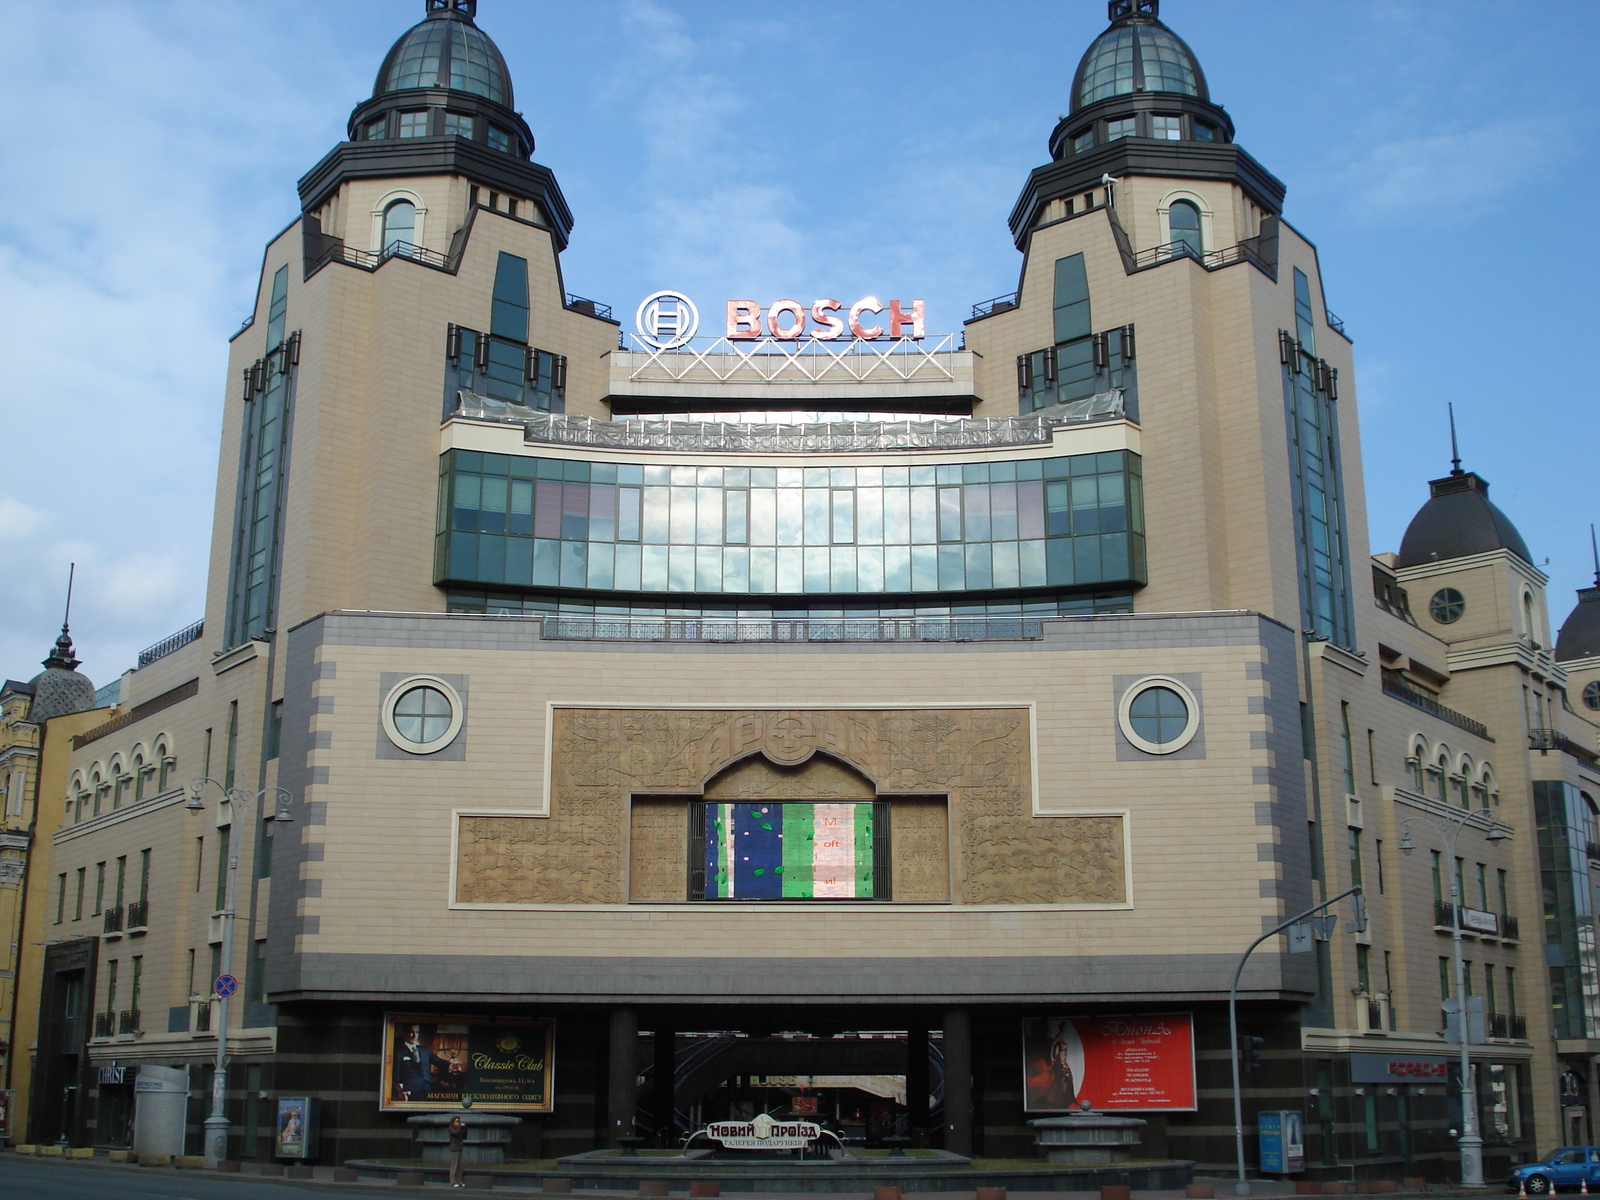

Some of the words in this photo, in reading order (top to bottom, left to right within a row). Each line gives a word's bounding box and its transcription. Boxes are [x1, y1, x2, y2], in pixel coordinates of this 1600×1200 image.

[726, 296, 925, 341] BOSCH
[471, 1052, 515, 1070] Classic
[516, 1054, 544, 1071] Club
[1387, 1062, 1448, 1076] PORSCHE
[98, 1060, 127, 1084] CHRIST
[757, 1139, 802, 1147] ПОДАРУНКІВ
